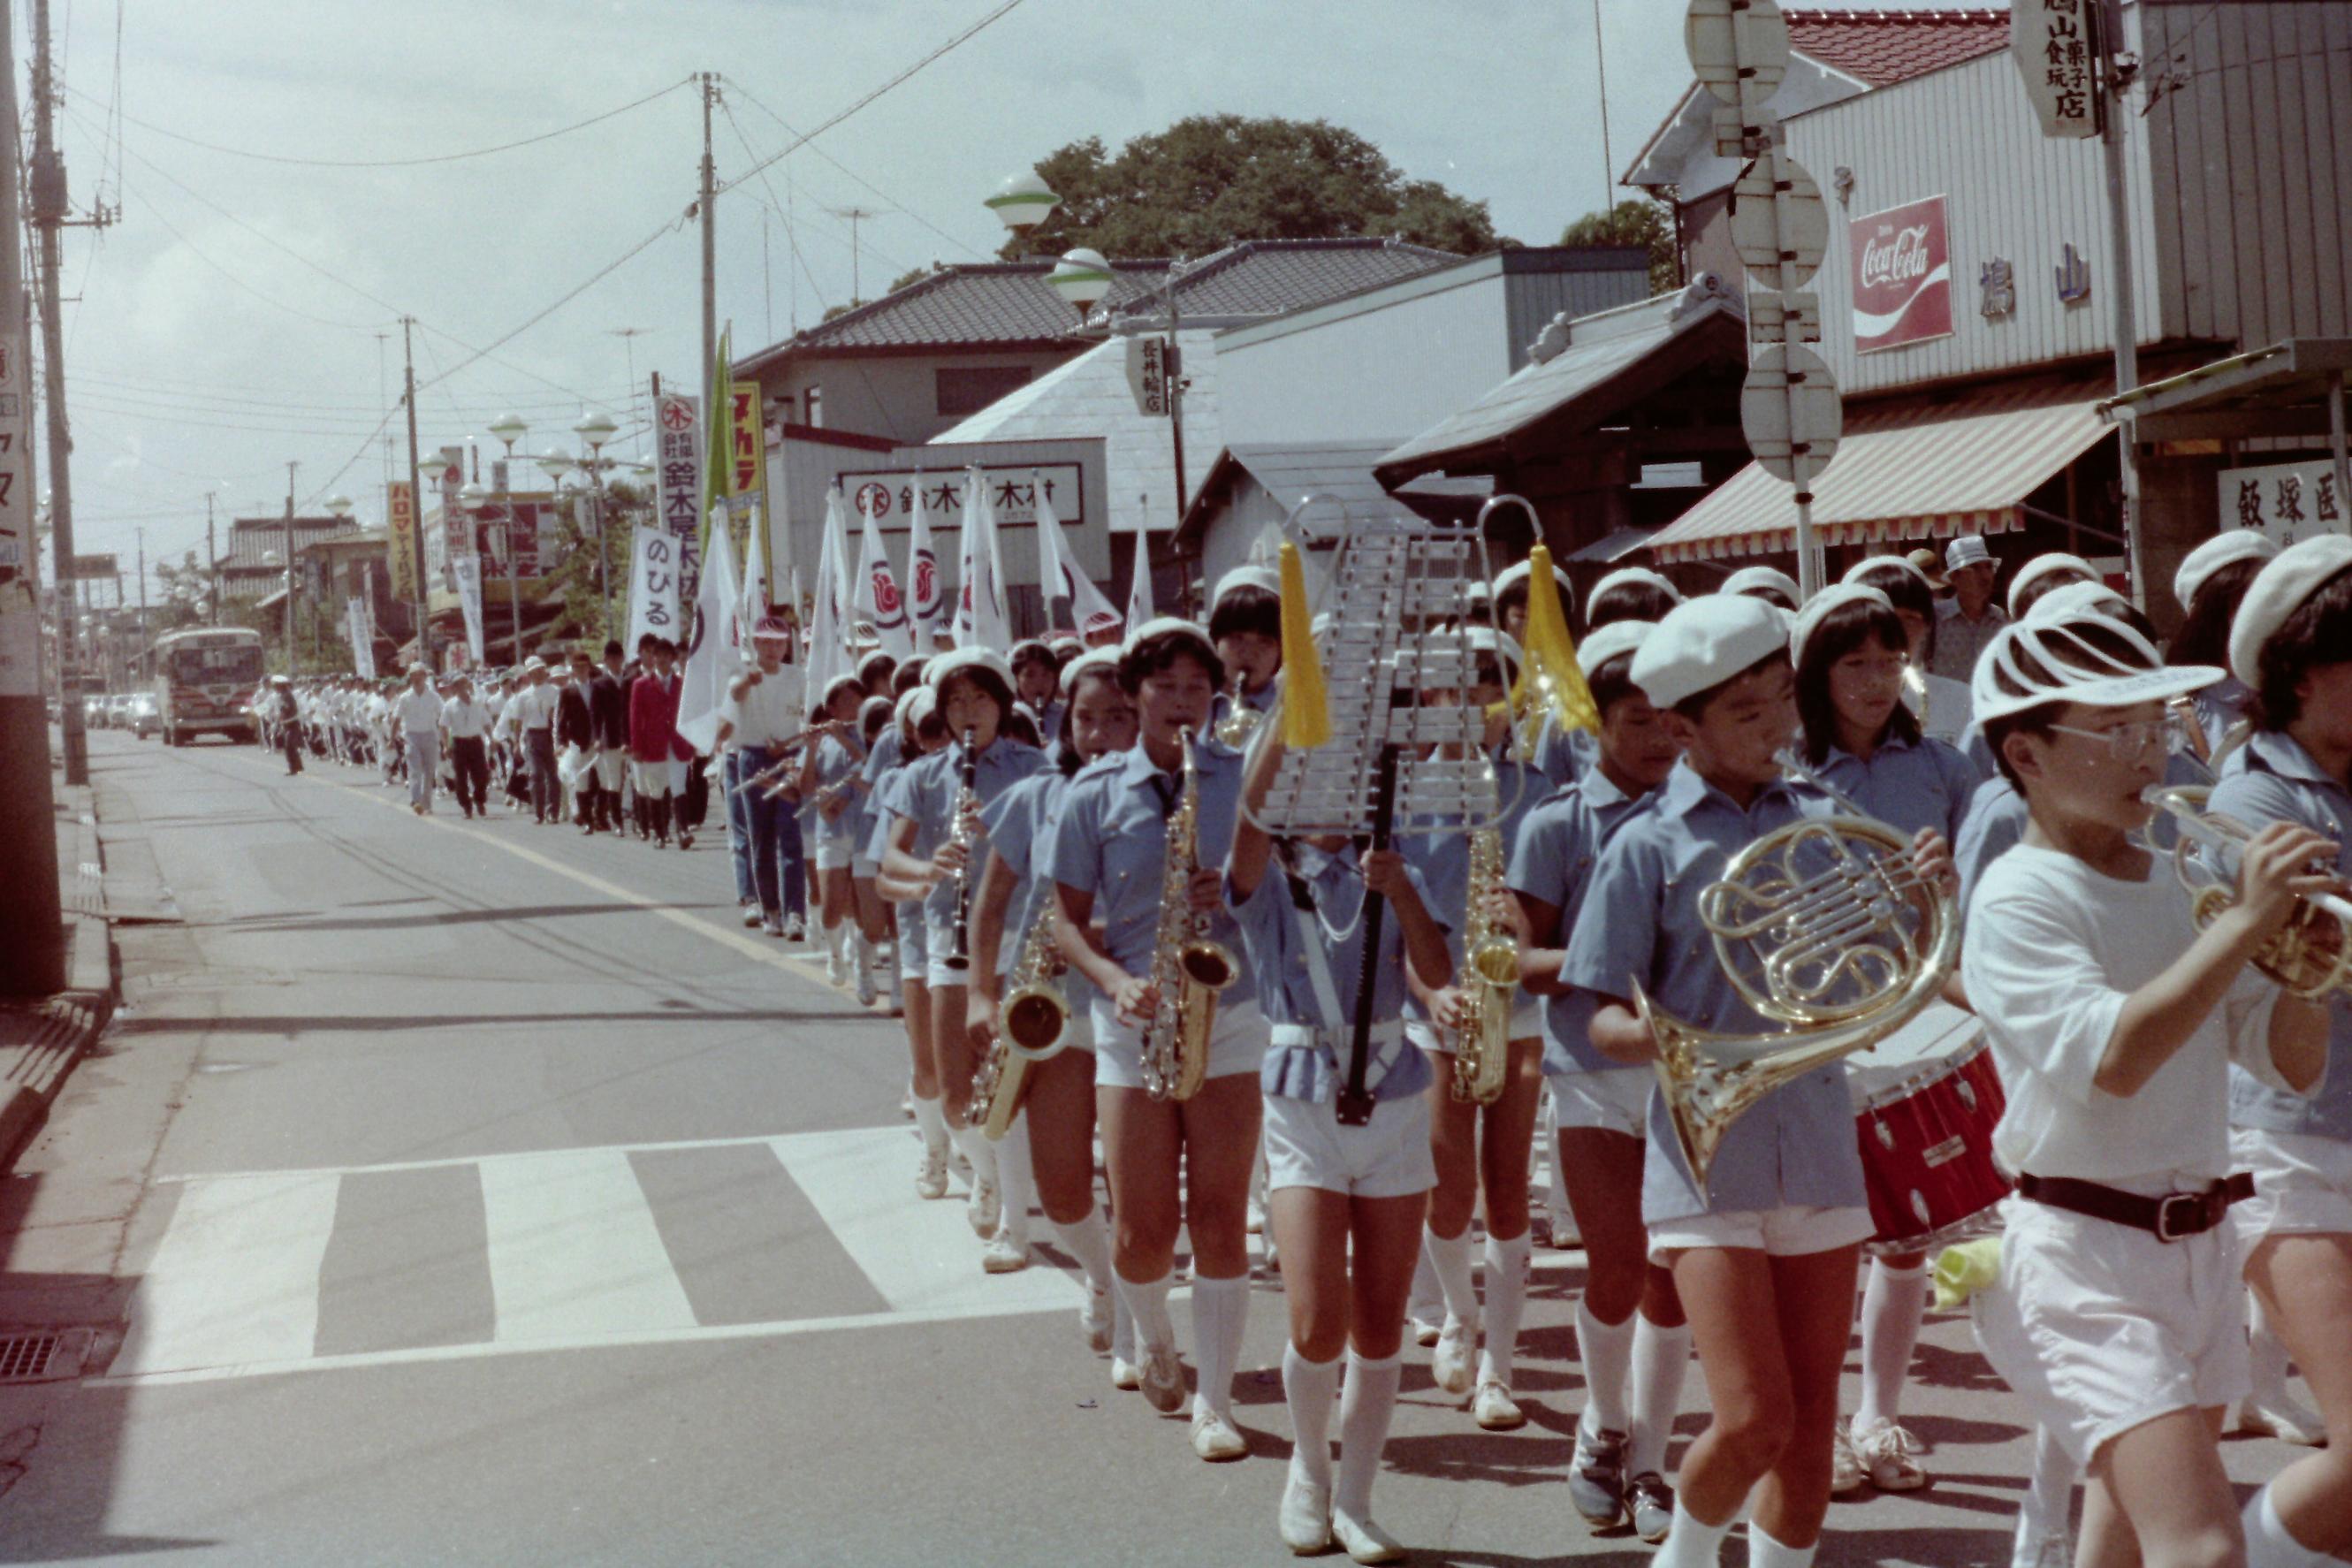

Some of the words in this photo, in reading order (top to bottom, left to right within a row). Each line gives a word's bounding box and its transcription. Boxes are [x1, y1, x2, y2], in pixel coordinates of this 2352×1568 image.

[1862, 224, 1930, 288] Coca-Cola
[900, 480, 1055, 514] 鈴木木材
[647, 537, 671, 626] のびる
